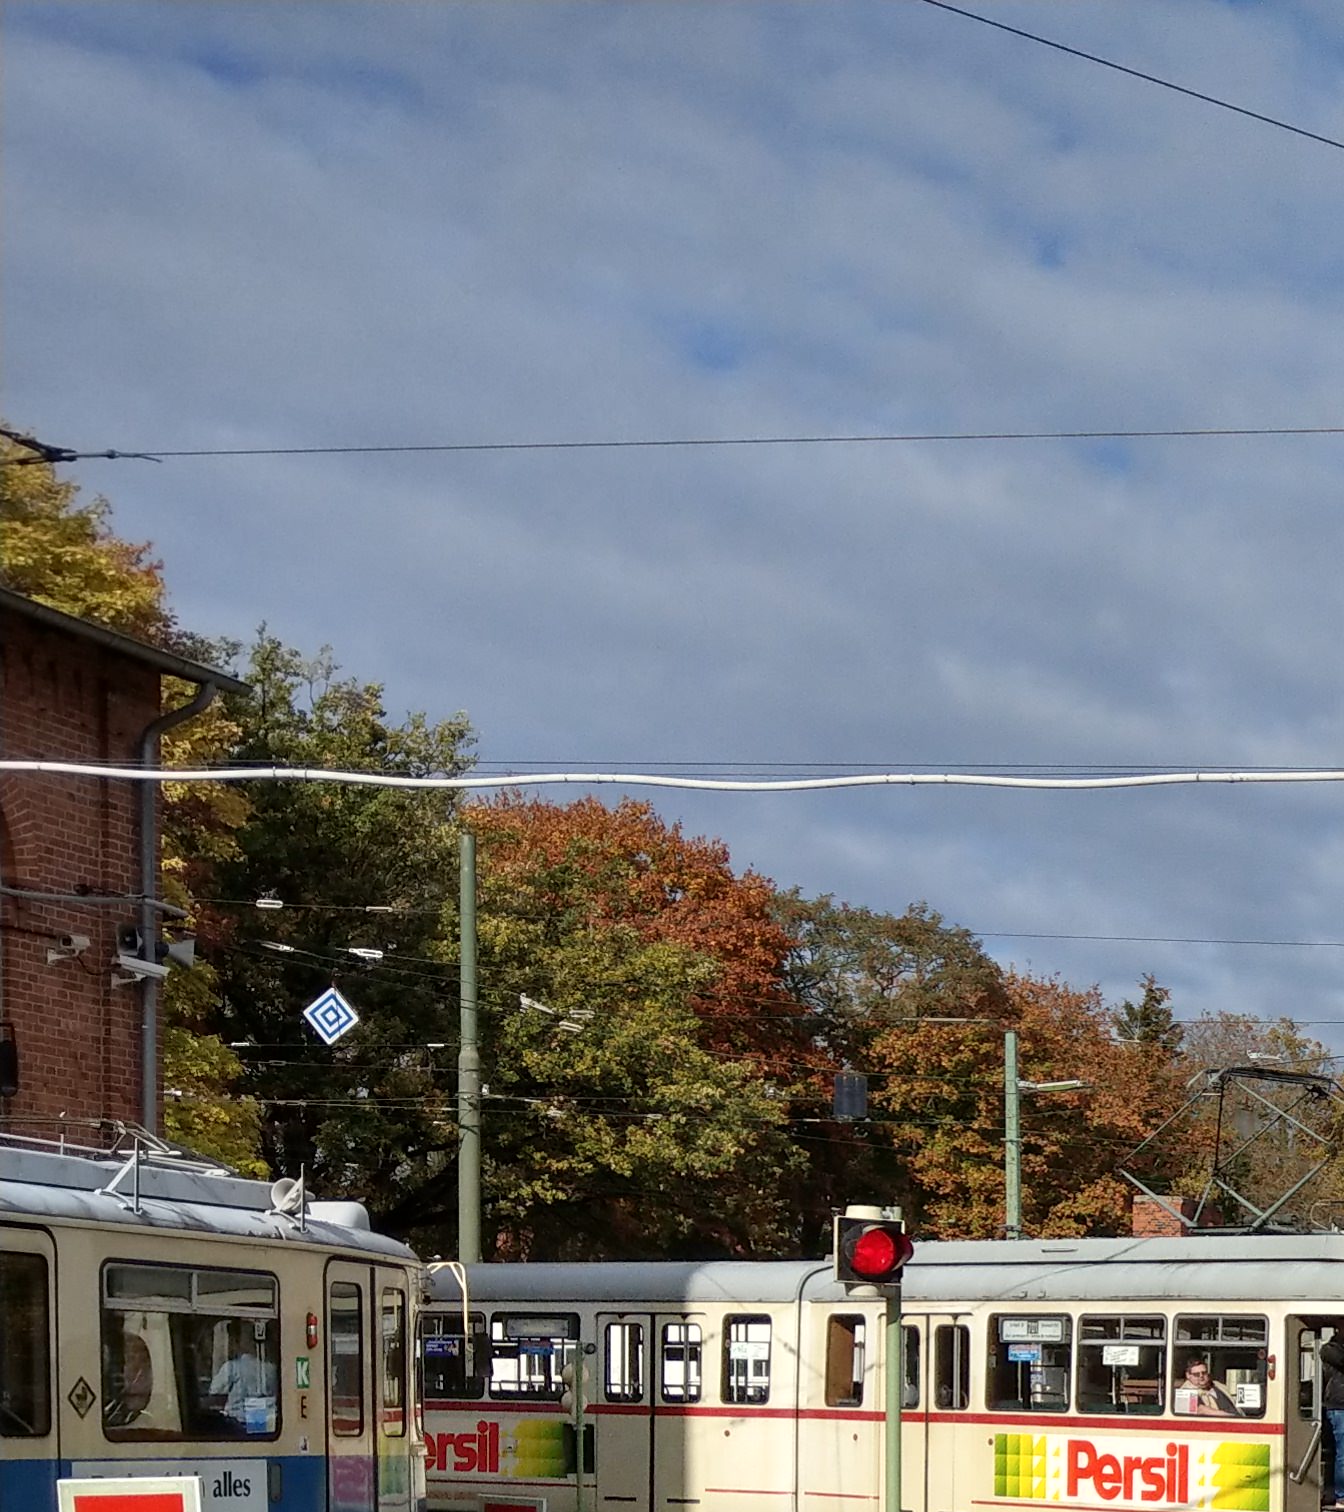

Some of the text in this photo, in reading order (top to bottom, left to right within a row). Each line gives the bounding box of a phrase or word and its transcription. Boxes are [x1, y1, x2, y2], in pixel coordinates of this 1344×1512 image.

[297, 1361, 309, 1385] K
[213, 1471, 251, 1498] alles
[1067, 1439, 1189, 1504] Persil
